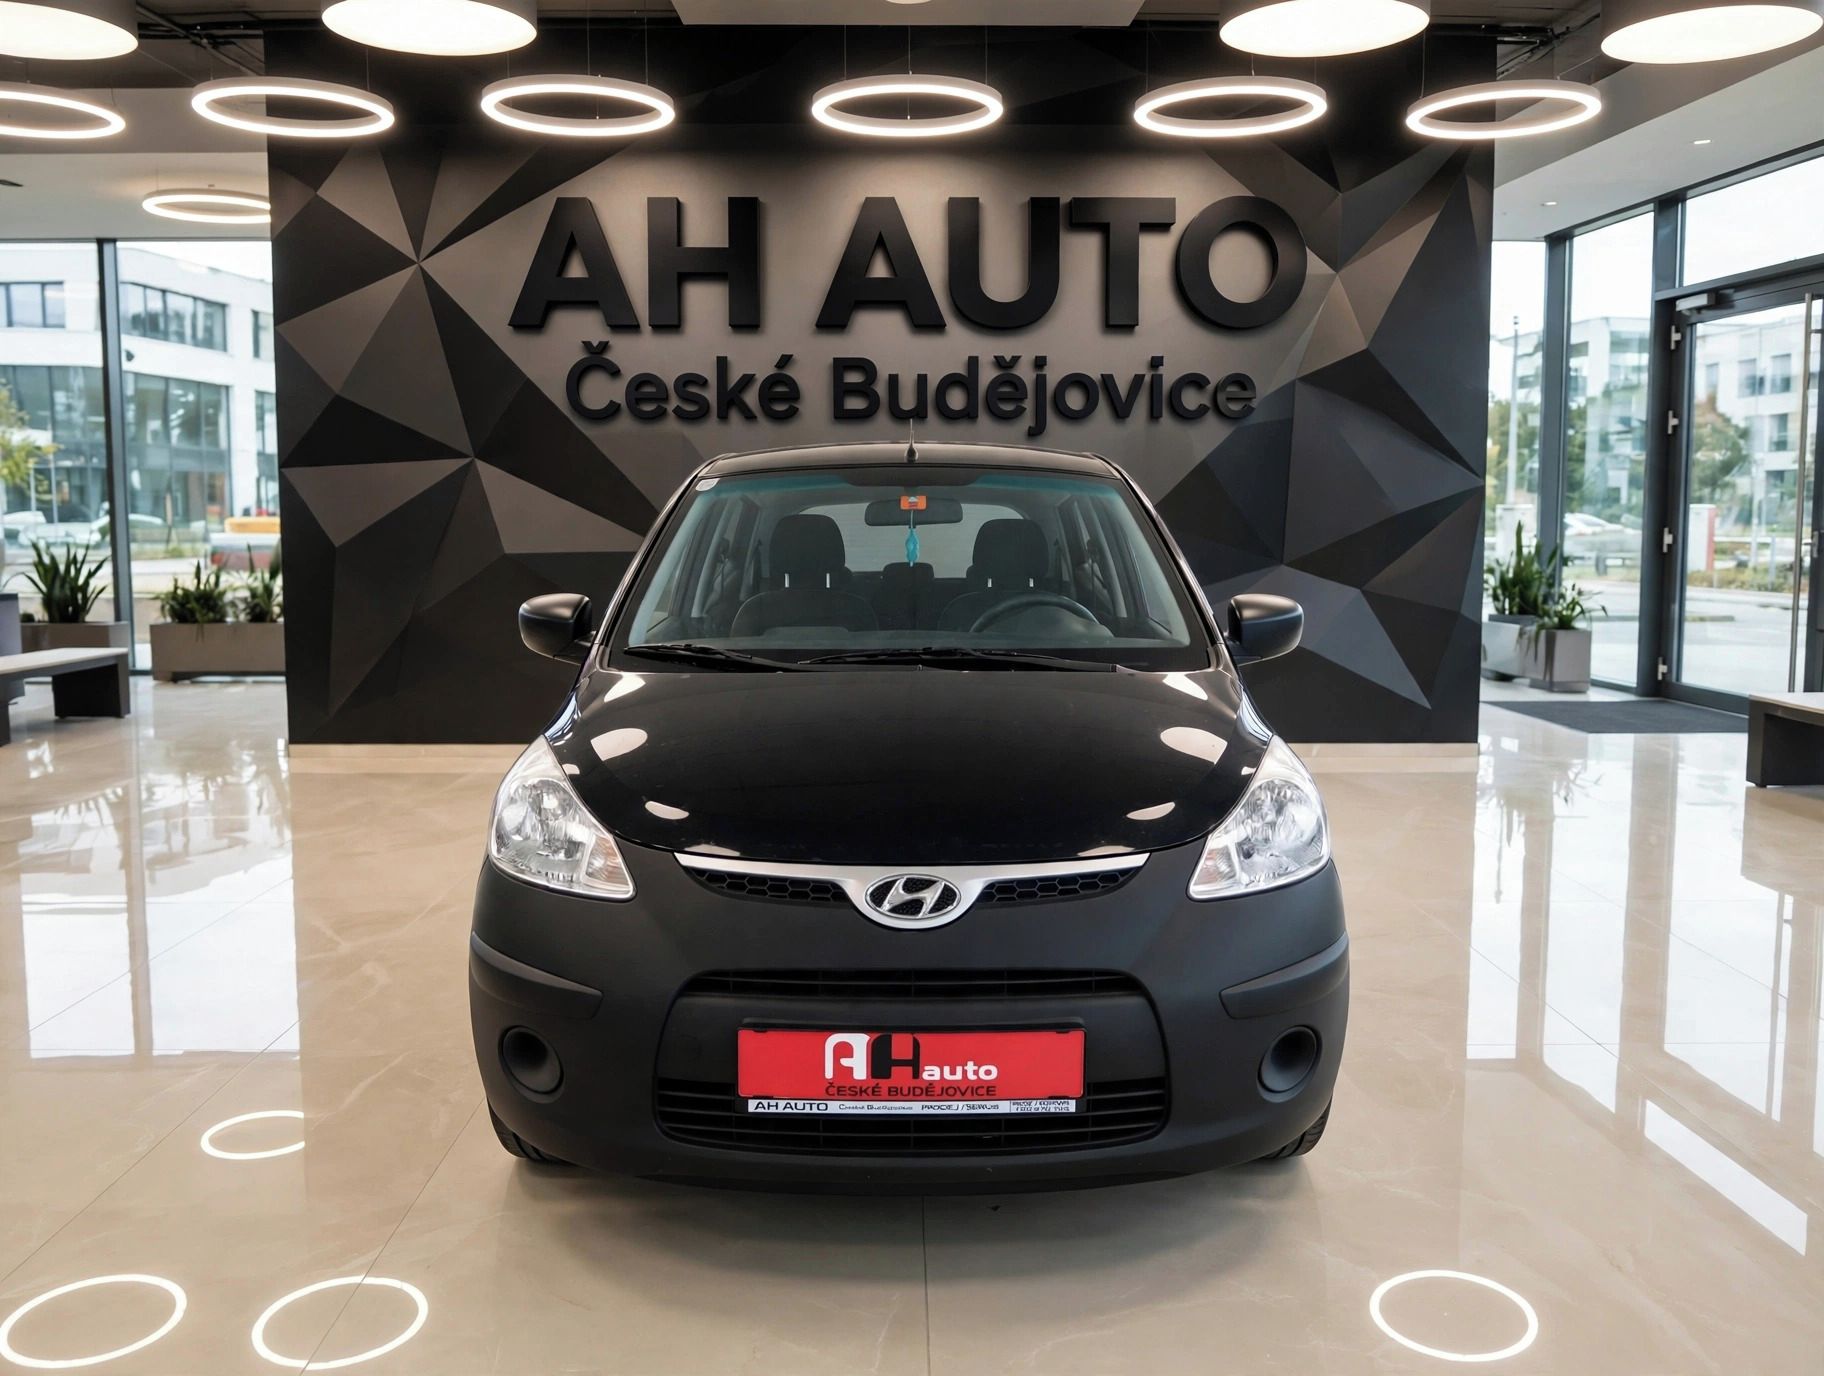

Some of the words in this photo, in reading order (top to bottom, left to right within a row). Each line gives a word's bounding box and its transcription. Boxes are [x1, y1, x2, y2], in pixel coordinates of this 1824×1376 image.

[508, 196, 761, 328] AH
[815, 195, 1308, 329] AUTO
[565, 340, 801, 420] České
[832, 355, 1257, 436] Budějovice
[754, 1101, 779, 1111] AH
[782, 1102, 829, 1112] AUTO
[825, 1082, 882, 1097] ČESKÉ
